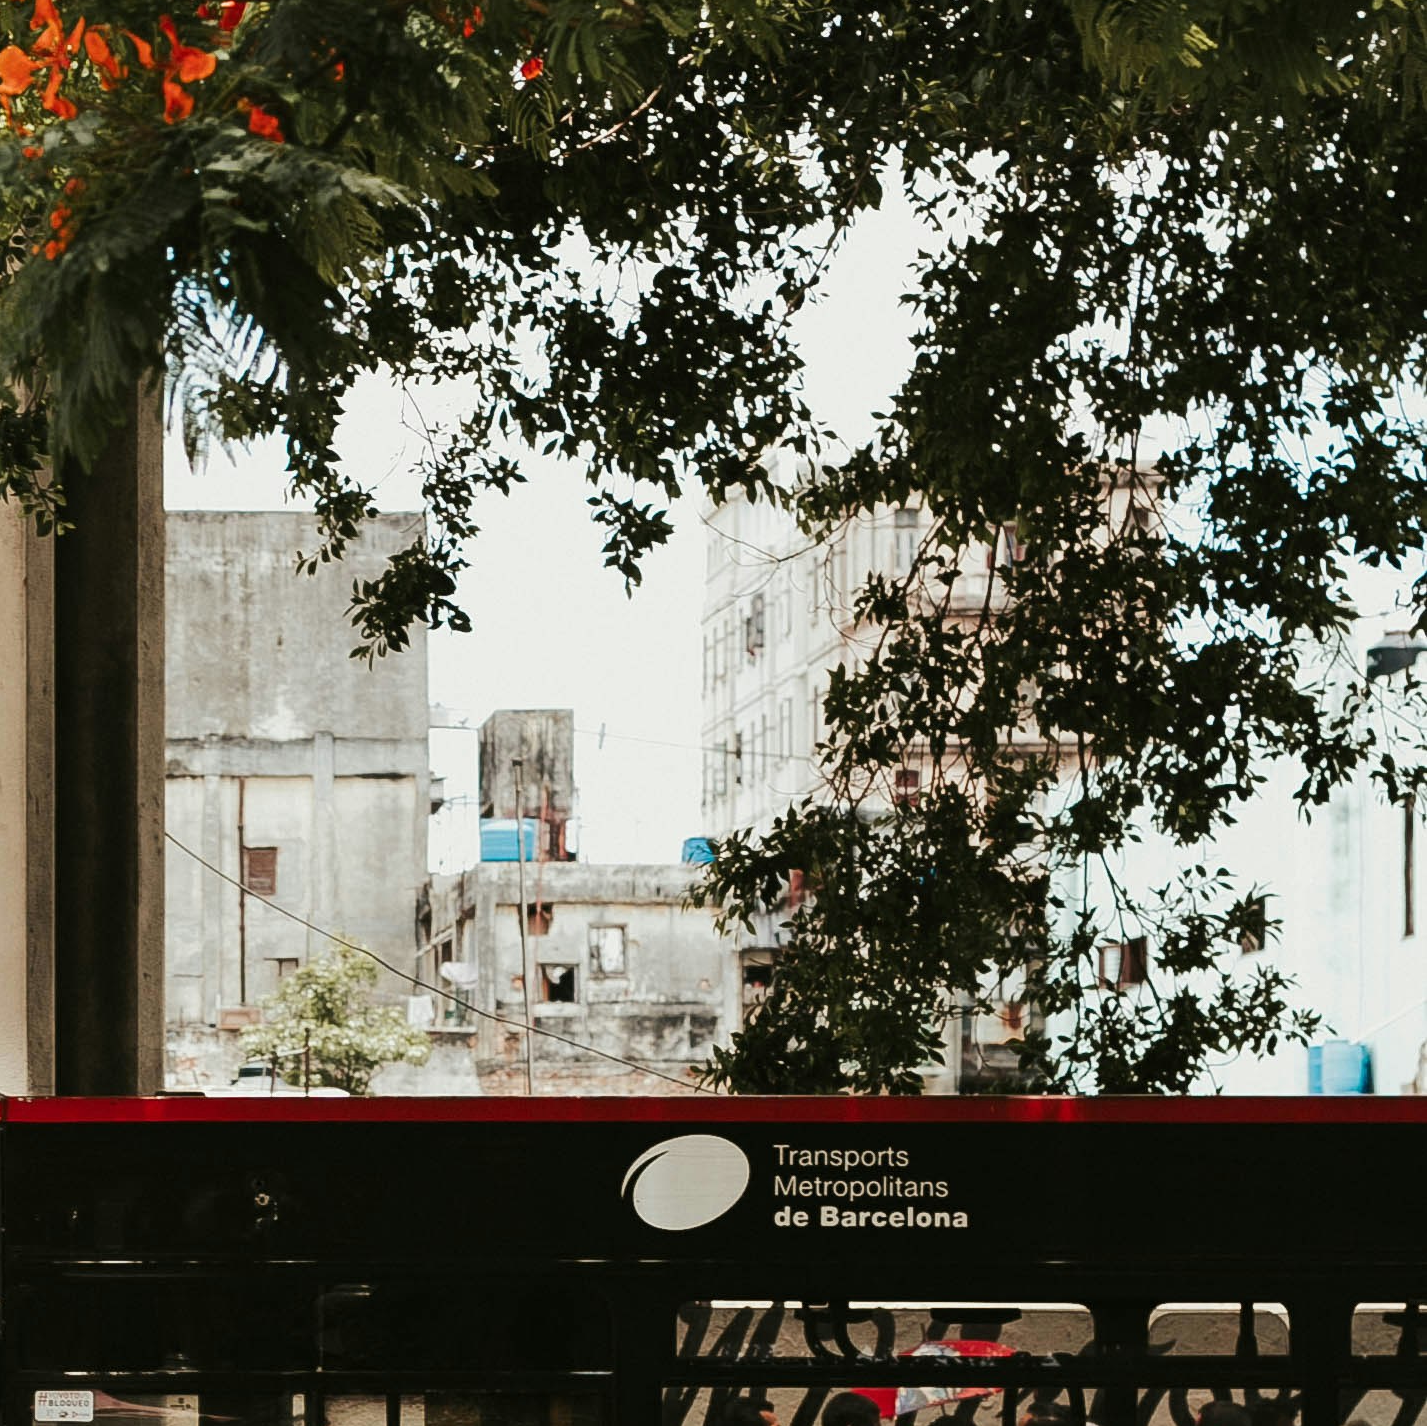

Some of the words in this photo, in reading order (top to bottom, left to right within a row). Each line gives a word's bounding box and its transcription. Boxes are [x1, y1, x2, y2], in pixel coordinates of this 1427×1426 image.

[773, 1144, 909, 1172] Transports
[774, 1175, 949, 1202] Metropolitans
[774, 1205, 809, 1227] de
[820, 1205, 969, 1228] Barcelona
[48, 1399, 90, 1407] BLOQUEO
